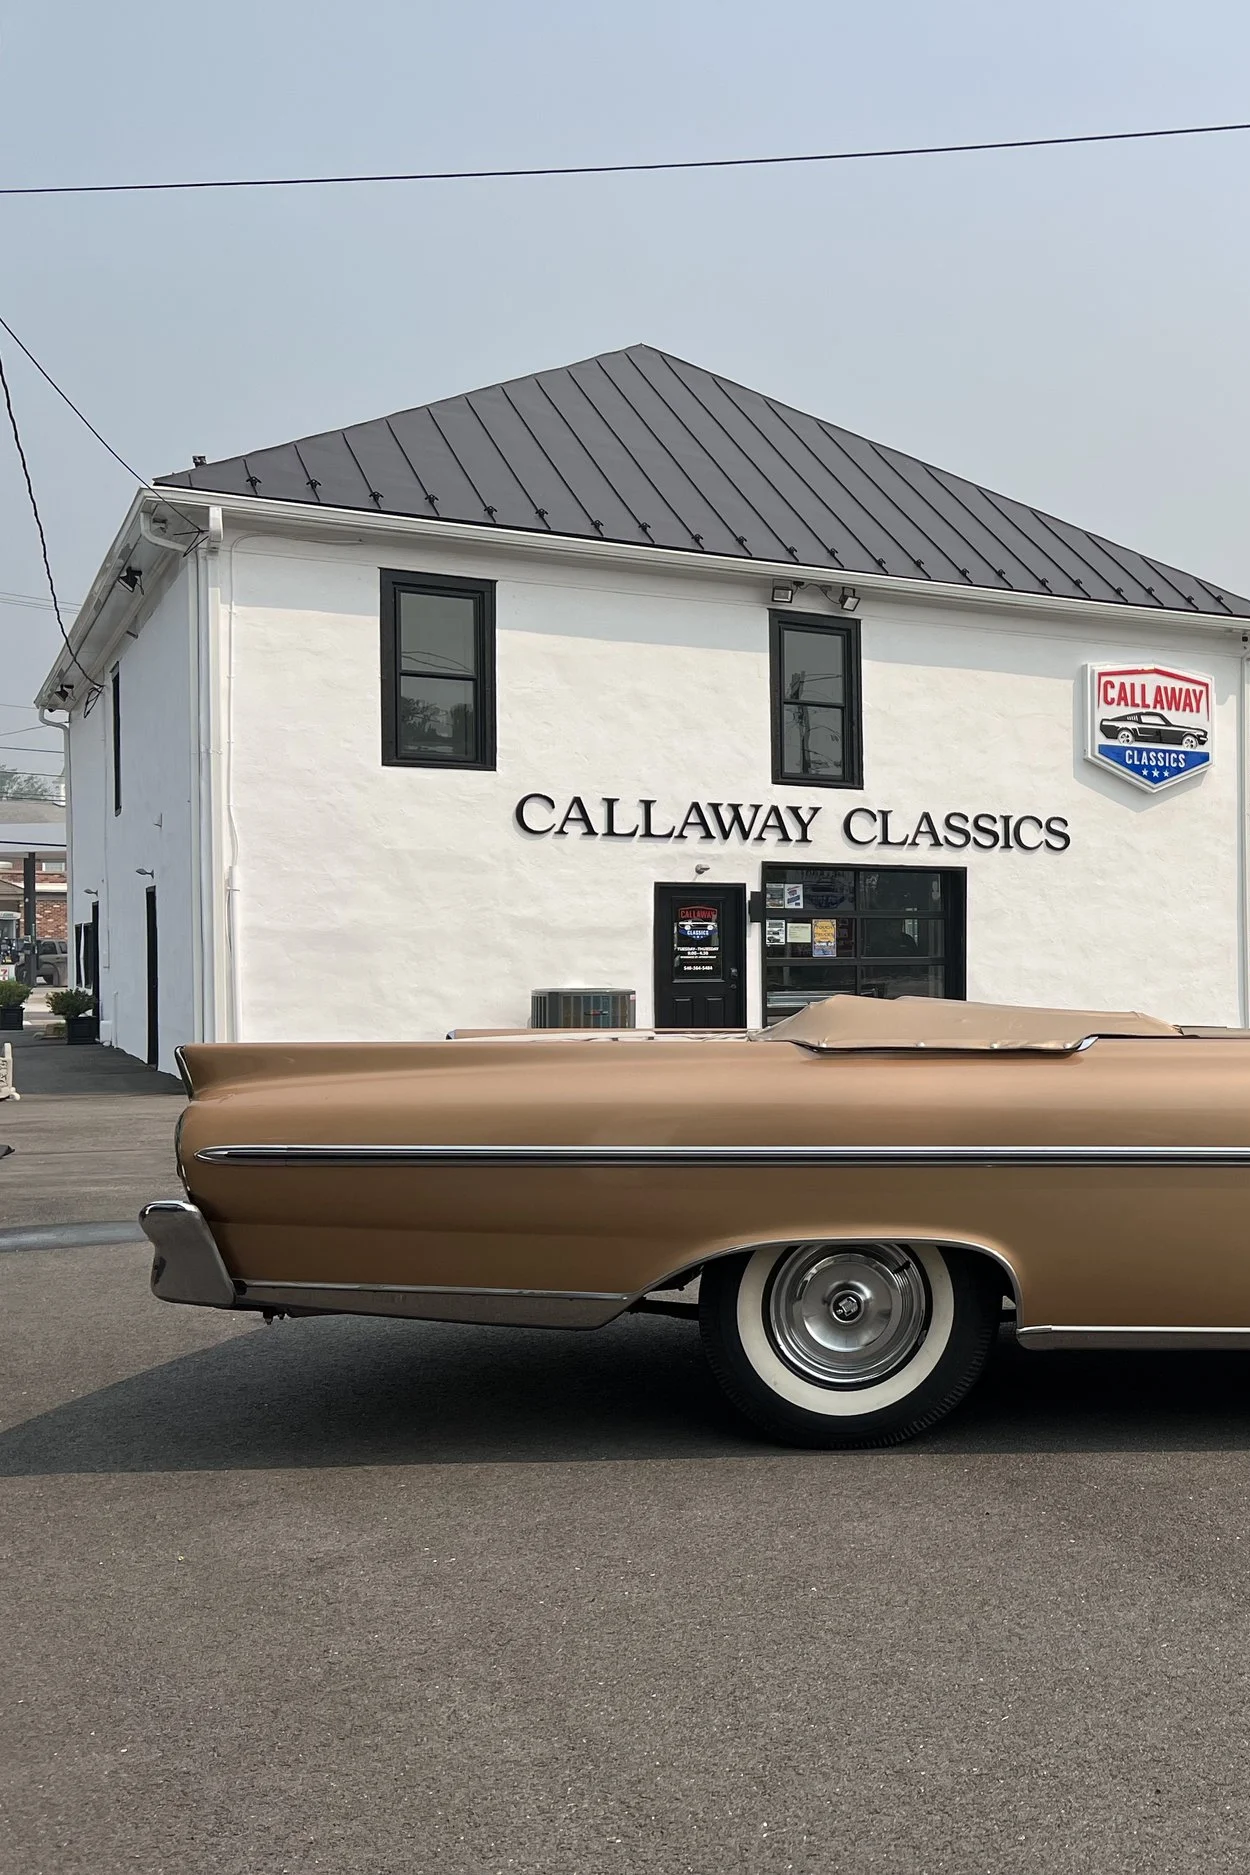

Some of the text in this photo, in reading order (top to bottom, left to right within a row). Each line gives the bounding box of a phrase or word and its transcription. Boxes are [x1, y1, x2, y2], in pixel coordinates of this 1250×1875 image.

[1103, 680, 1204, 714] CALLAWAY
[1125, 750, 1186, 768] CLASSICS
[515, 793, 1071, 852] CALLAWAY CLASSICS
[680, 910, 716, 919] CALLAWAY
